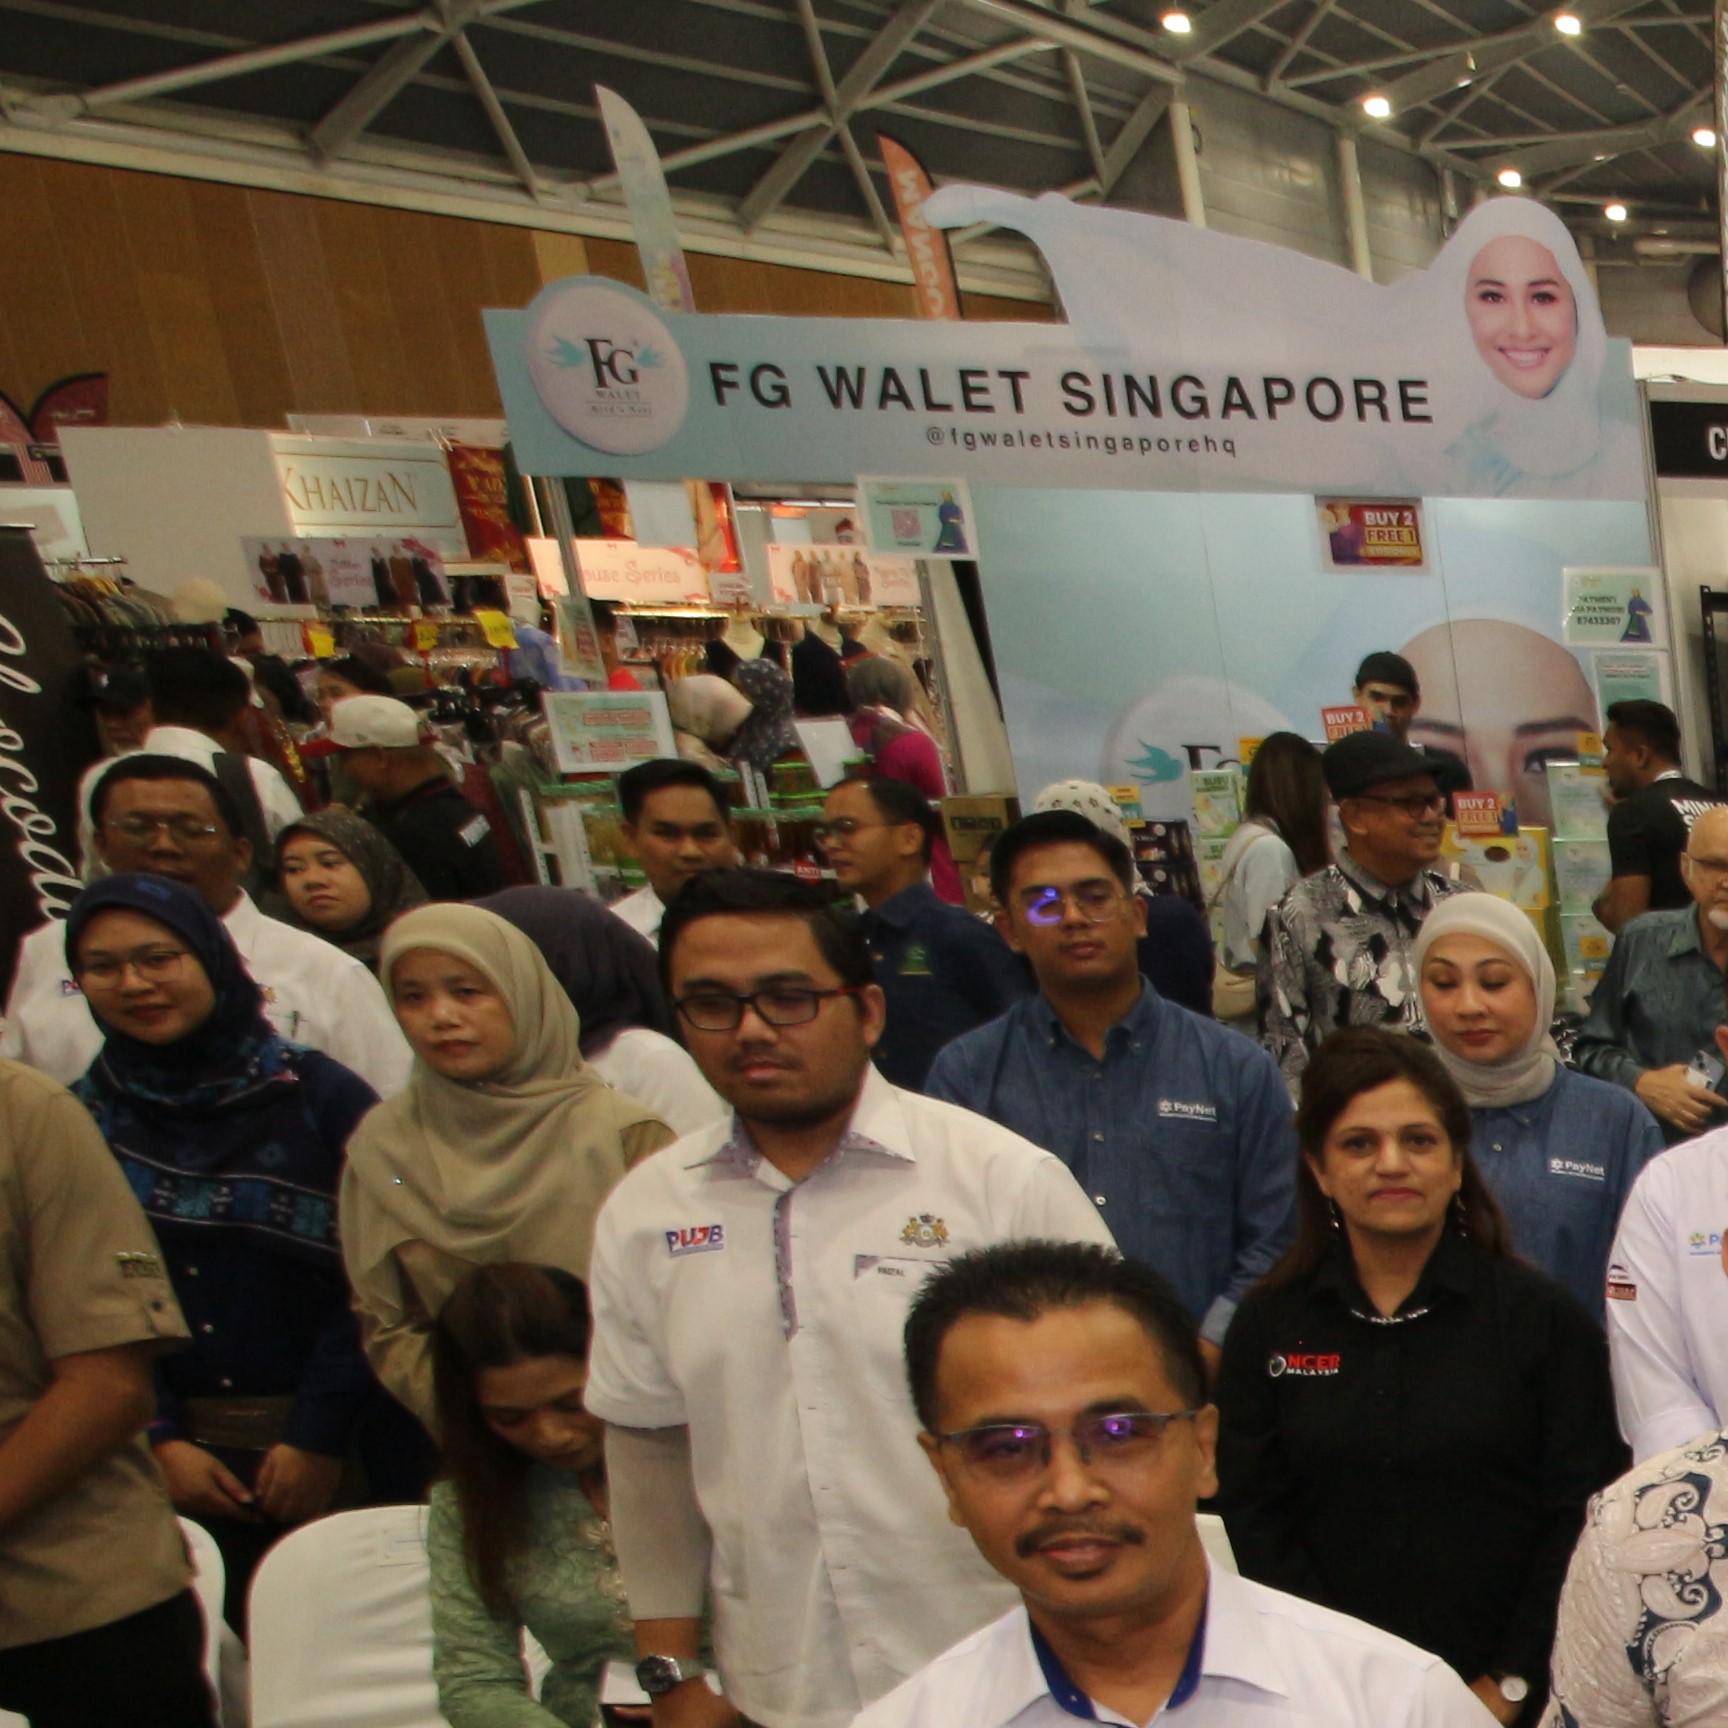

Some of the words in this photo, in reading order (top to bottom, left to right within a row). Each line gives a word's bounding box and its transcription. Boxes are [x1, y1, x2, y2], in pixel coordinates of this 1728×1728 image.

[584, 338, 640, 388] FG
[709, 362, 793, 410] FG
[816, 364, 1031, 415] WALET
[1061, 369, 1435, 425] SINGAPORE
[926, 427, 1237, 458] @fgwaletsingaporehq
[284, 467, 419, 513] KHAIZAN
[1365, 511, 1399, 526] BUY
[1403, 511, 1414, 525] 2
[1367, 530, 1405, 544] FREE
[1409, 531, 1415, 543] 1
[1326, 712, 1354, 725] BUY
[1356, 711, 1365, 723] 2
[1457, 798, 1486, 810] BUY
[1488, 798, 1496, 810] 2
[1173, 1101, 1216, 1116] PayNet
[1564, 1160, 1605, 1176] PayNet
[665, 1225, 725, 1252] PUJB
[1286, 1354, 1341, 1369] NCER
